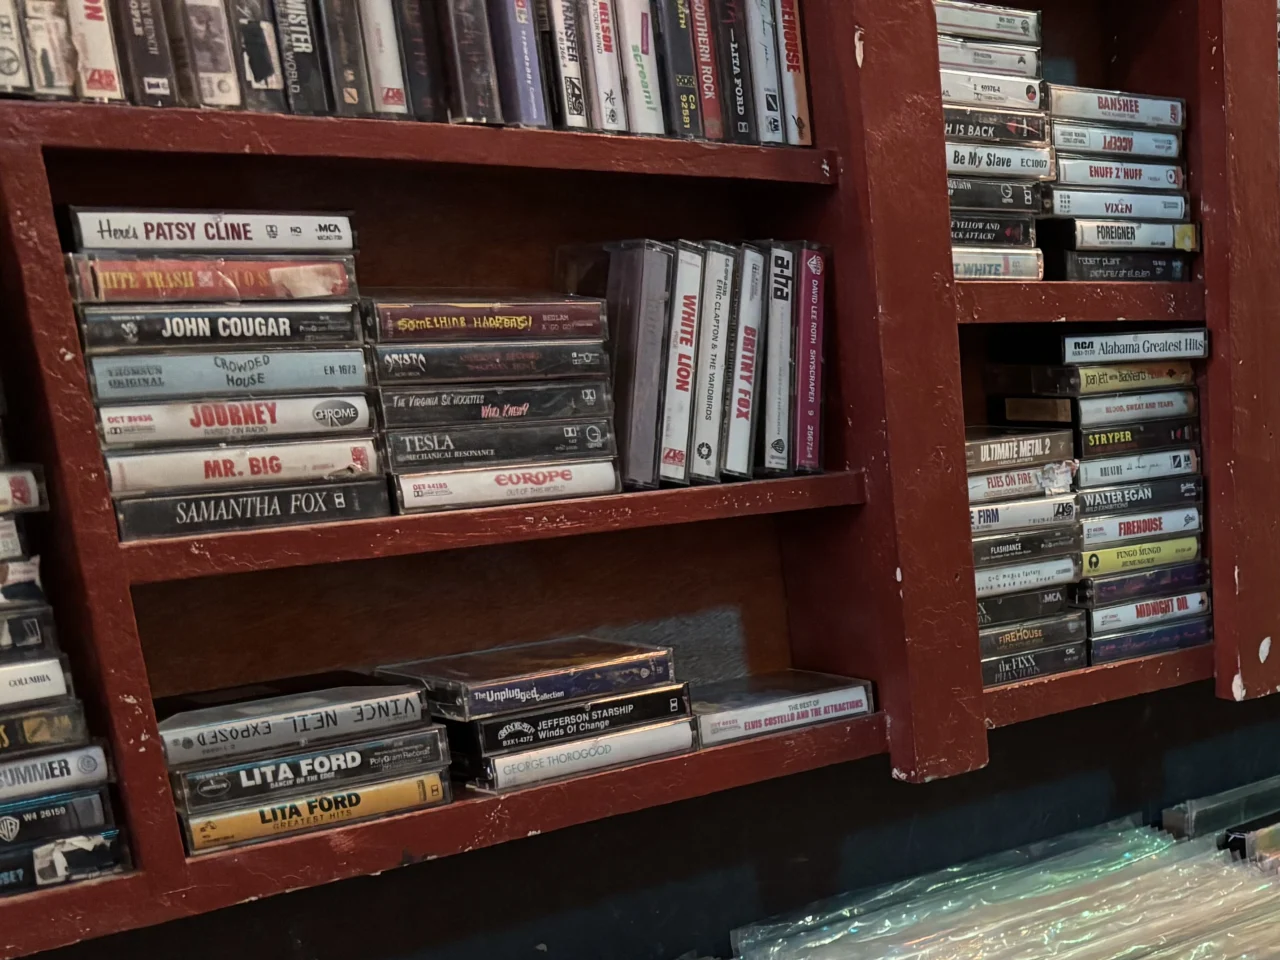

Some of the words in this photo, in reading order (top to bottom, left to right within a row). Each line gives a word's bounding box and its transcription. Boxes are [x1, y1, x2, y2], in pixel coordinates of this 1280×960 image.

[596, 0, 613, 53] NELSON
[285, 50, 300, 94] WORLD
[701, 74, 714, 100] ROCK
[733, 68, 745, 116] FORD
[1097, 96, 1140, 113] BANSHEE
[955, 125, 964, 135] IS
[968, 126, 995, 137] BACK
[953, 151, 965, 165] Be
[968, 152, 983, 168] My
[986, 153, 1011, 168] Slave
[1020, 158, 1048, 168] EC1007
[1089, 165, 1114, 179] ENUFF
[1104, 202, 1132, 214] VIXEN
[144, 222, 197, 240] PATSY
[205, 223, 253, 241] CLINE
[1096, 225, 1136, 241] FOREIGNER
[960, 263, 1001, 276] WHITE
[162, 317, 211, 337] JOHN
[218, 317, 291, 337] COUGAR
[680, 295, 697, 347] WHITE
[712, 302, 721, 340] CLAPTON
[740, 326, 756, 382] BRITNY
[1098, 342, 1140, 355] Alabama
[1143, 340, 1182, 353] Greatest
[1185, 338, 1204, 351] Hits
[214, 355, 270, 372] CROWDED
[676, 354, 691, 392] LION
[226, 373, 266, 388] HOUSE
[808, 349, 817, 403] SKYSCRAPER
[705, 373, 715, 420] YARDBIRDS
[736, 389, 751, 421] FOX
[190, 402, 278, 428] JOURNEY
[314, 406, 357, 420] CHROME
[400, 435, 455, 452] TESLA
[1089, 431, 1132, 446] STRYPER
[980, 442, 1017, 462] ULTIMATE
[1020, 440, 1043, 457] METAL
[204, 460, 244, 479] MR.
[249, 456, 282, 474] BIG
[494, 469, 573, 485] EUROPE
[986, 475, 1004, 489] FLIES
[1005, 475, 1016, 486] ON
[1018, 472, 1032, 484] FIRE
[1084, 490, 1122, 507] WALTER
[1123, 487, 1152, 502] EGAN
[176, 496, 282, 524] SAMANTHA
[290, 493, 328, 512] FOX
[978, 508, 999, 524] FIRM
[1119, 517, 1163, 536] FIREHOUSE
[991, 543, 1022, 554] FLASHDANCE
[1135, 602, 1174, 619] MIDNIGHT
[1177, 596, 1189, 611] OIL
[999, 629, 1042, 645] FIREHOUSE
[486, 686, 538, 704] Unplugged
[353, 698, 416, 723] VINCE
[537, 713, 589, 730] JEFFERSON
[591, 704, 634, 719] STARSHIP
[284, 709, 338, 733] NEIL
[538, 728, 564, 740] Winds
[567, 726, 577, 736] Of
[579, 720, 610, 734] Change
[197, 721, 272, 746] EXPOSED
[239, 764, 295, 788] LITA
[300, 751, 362, 776] FORD
[503, 759, 545, 775] GEORGE
[547, 744, 612, 766] THOROGOOD
[259, 805, 302, 825] LITA
[307, 793, 361, 815] FORD
[272, 814, 324, 830] GREATEST
[330, 810, 352, 820] HITS
